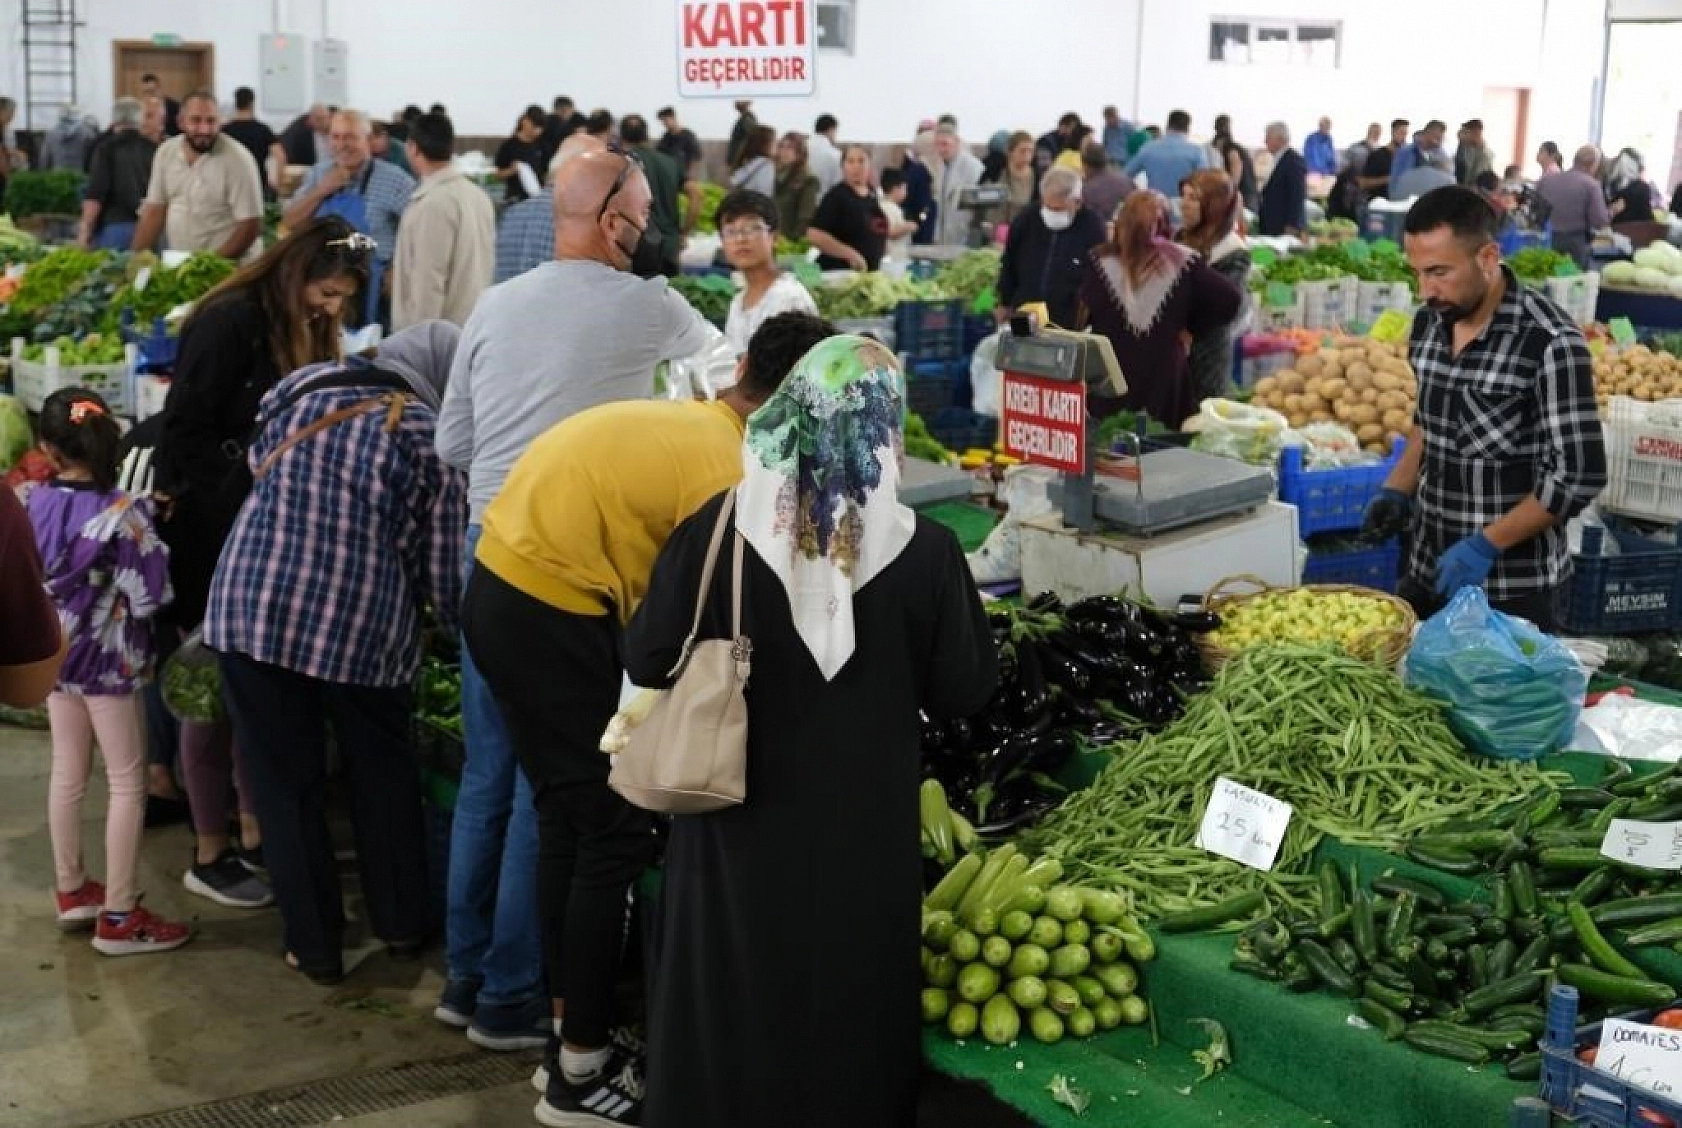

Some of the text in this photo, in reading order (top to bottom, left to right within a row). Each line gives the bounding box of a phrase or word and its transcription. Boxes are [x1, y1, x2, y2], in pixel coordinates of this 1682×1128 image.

[684, 1, 806, 47] KARTI
[1042, 390, 1081, 424] KARTI
[1217, 812, 1246, 837] 25
